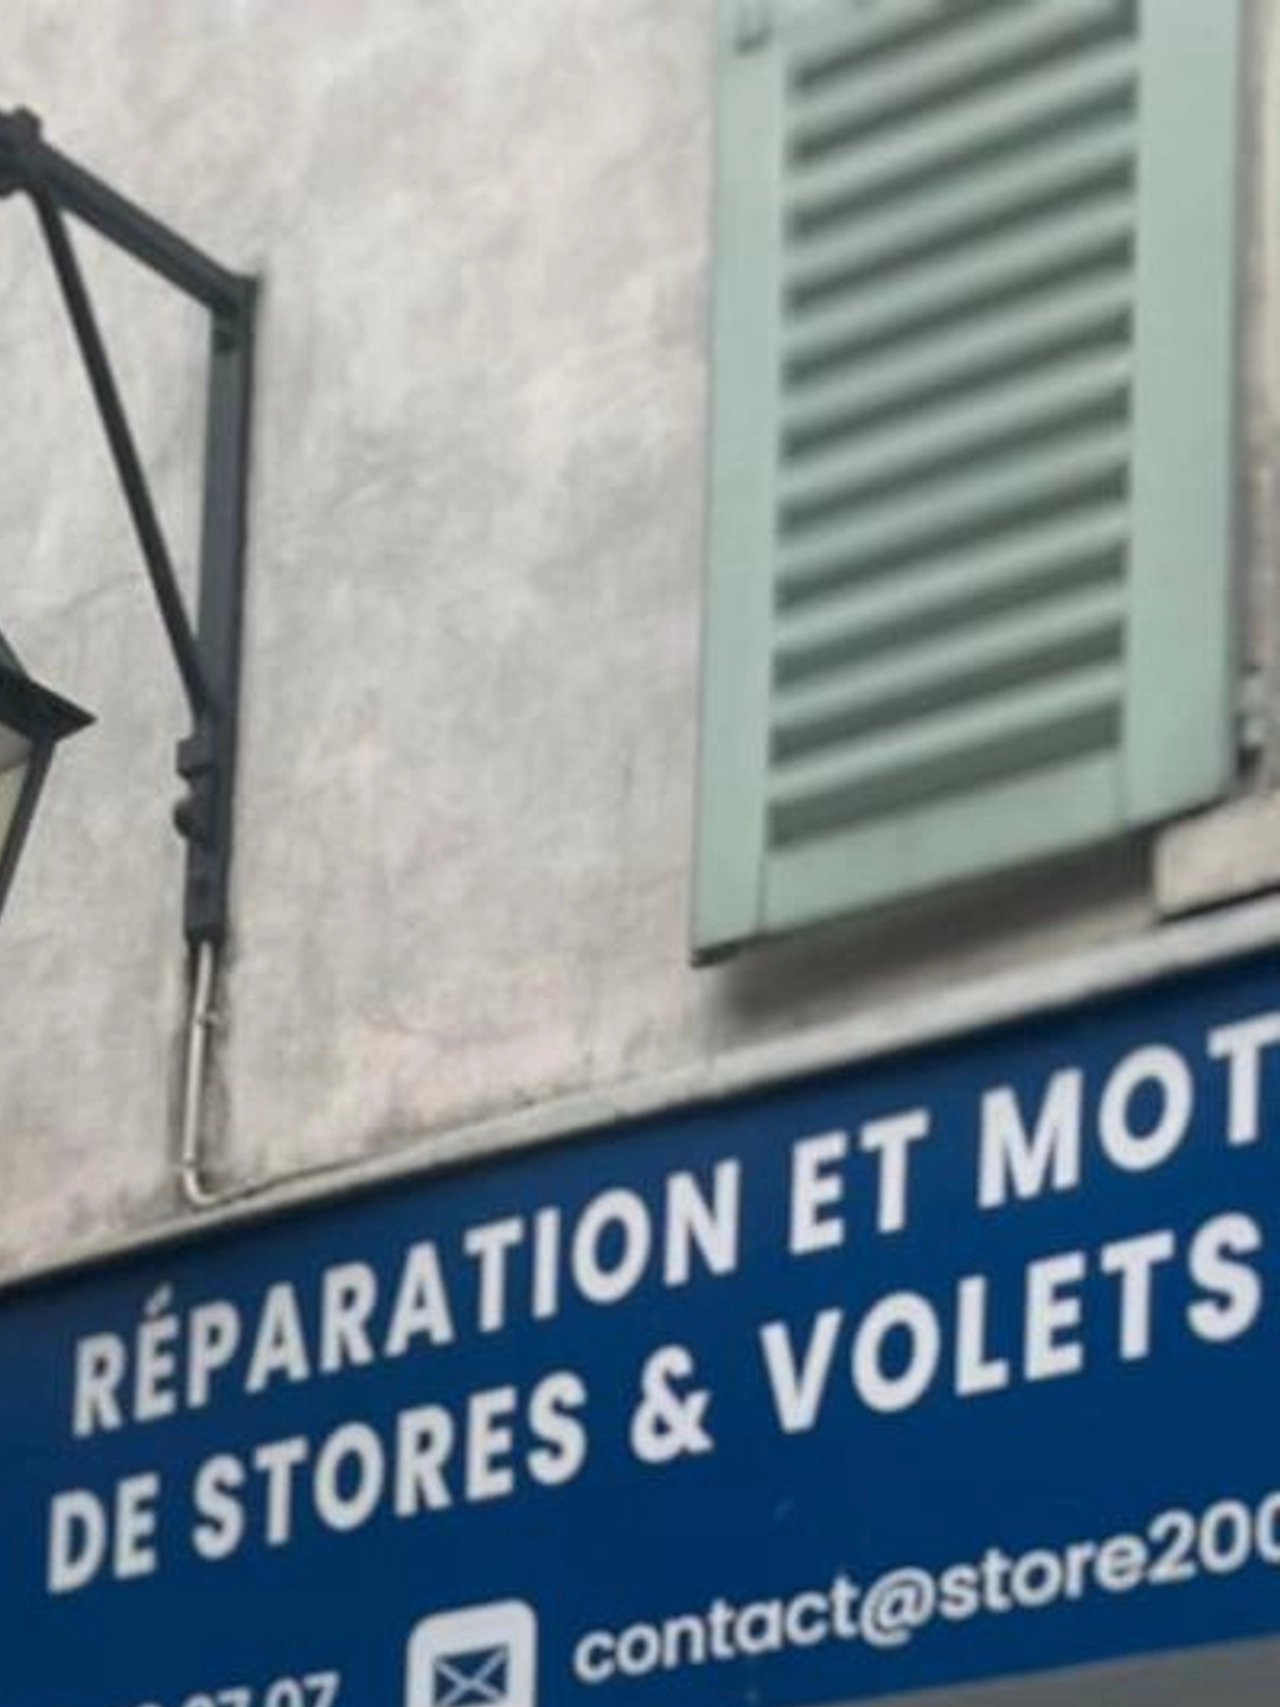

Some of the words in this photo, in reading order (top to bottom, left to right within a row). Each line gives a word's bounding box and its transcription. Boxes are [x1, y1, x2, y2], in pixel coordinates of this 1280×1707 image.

[47, 1473, 160, 1594] DE
[192, 1371, 587, 1559] STORES
[630, 1345, 714, 1464] &
[759, 1212, 1263, 1434] VOLETS
[73, 1158, 740, 1438] RÉPARATION
[789, 1107, 929, 1257] ET
[977, 1010, 1280, 1210] MOT
